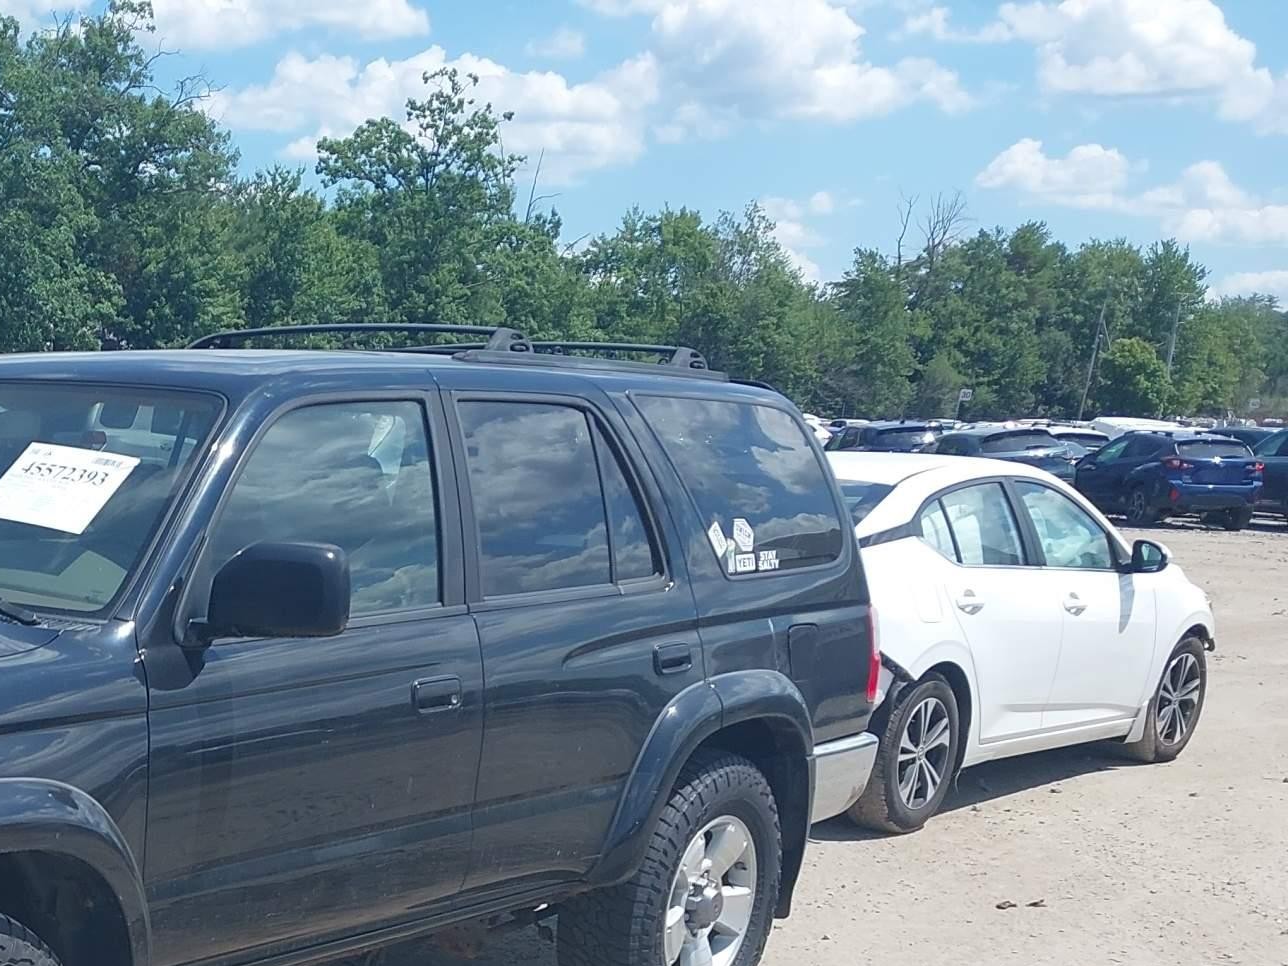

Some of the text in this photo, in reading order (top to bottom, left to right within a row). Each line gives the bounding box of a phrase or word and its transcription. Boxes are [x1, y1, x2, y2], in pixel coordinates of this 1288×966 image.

[21, 461, 109, 487] 45572393
[759, 550, 777, 561] STAY
[737, 557, 754, 568] YETI
[758, 559, 780, 571] SALTY
